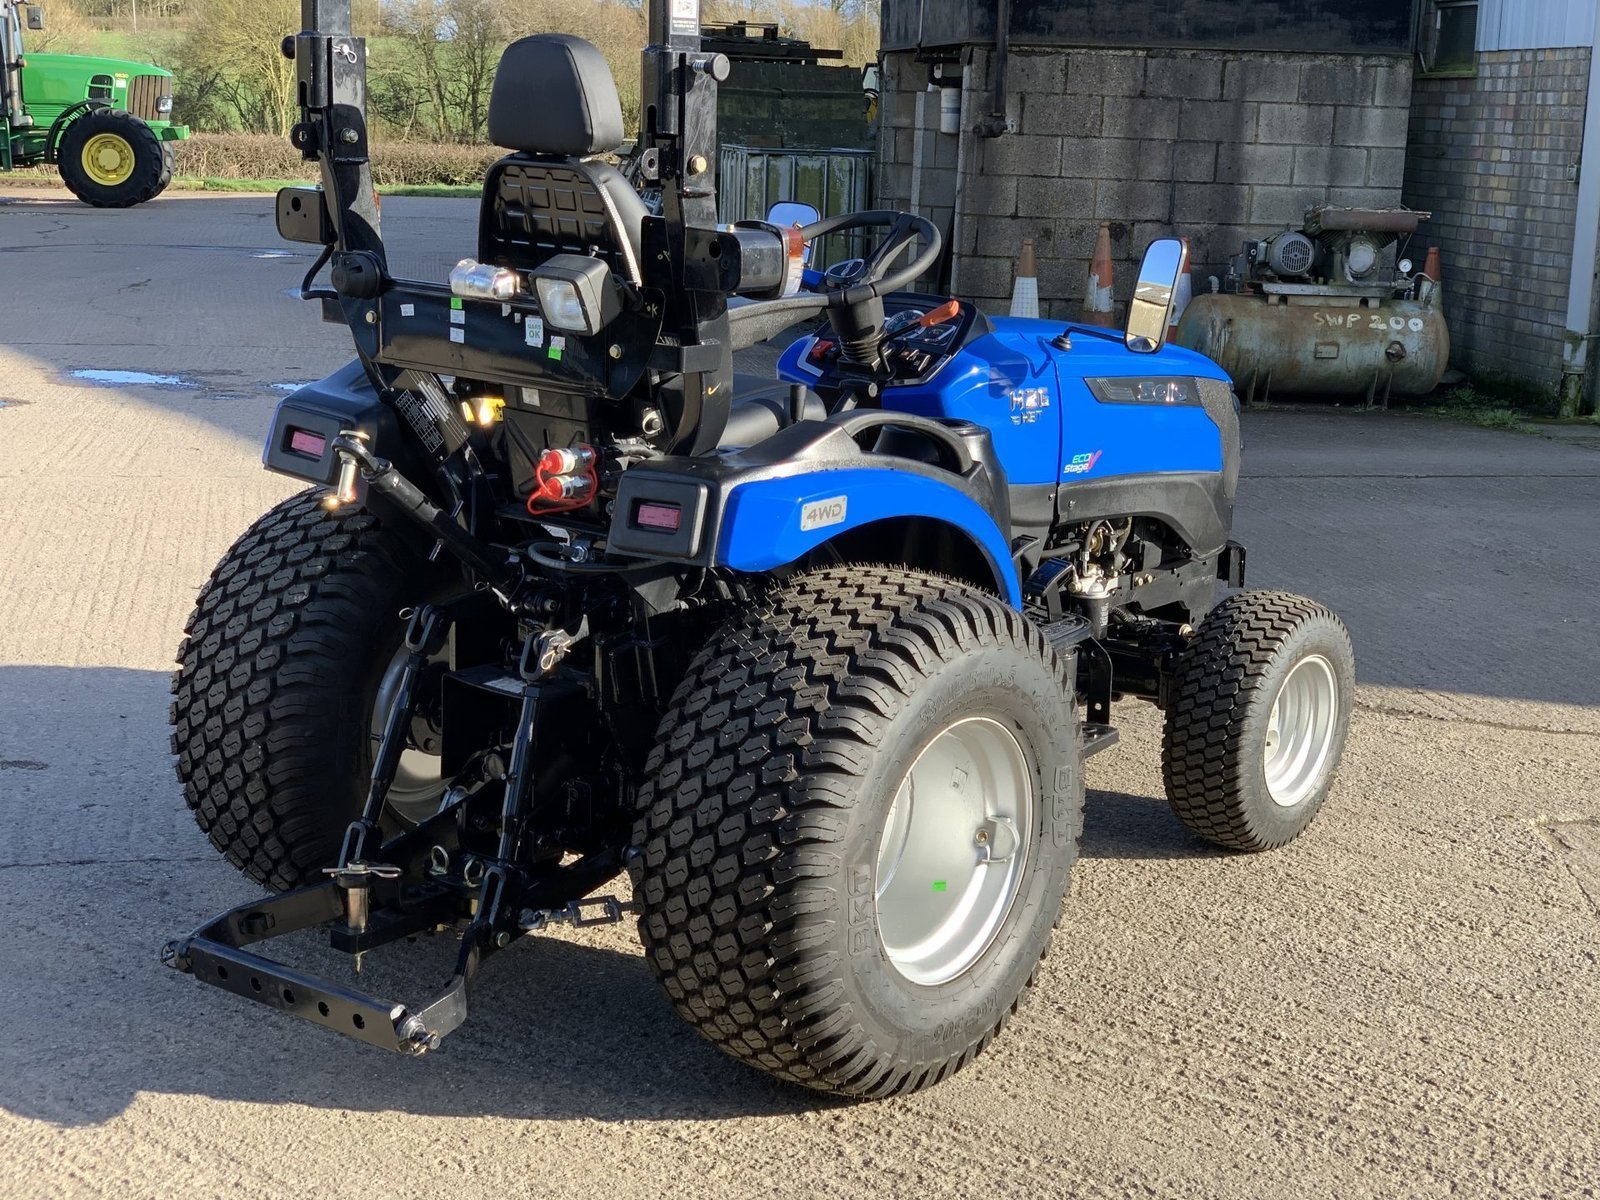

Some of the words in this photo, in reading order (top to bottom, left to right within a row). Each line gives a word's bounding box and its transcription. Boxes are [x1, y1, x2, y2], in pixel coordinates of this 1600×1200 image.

[1368, 314, 1424, 332] 200
[528, 330, 541, 339] OK
[1063, 463, 1090, 474] Stage
[806, 503, 843, 522] 4WD
[847, 864, 872, 957] BKT
